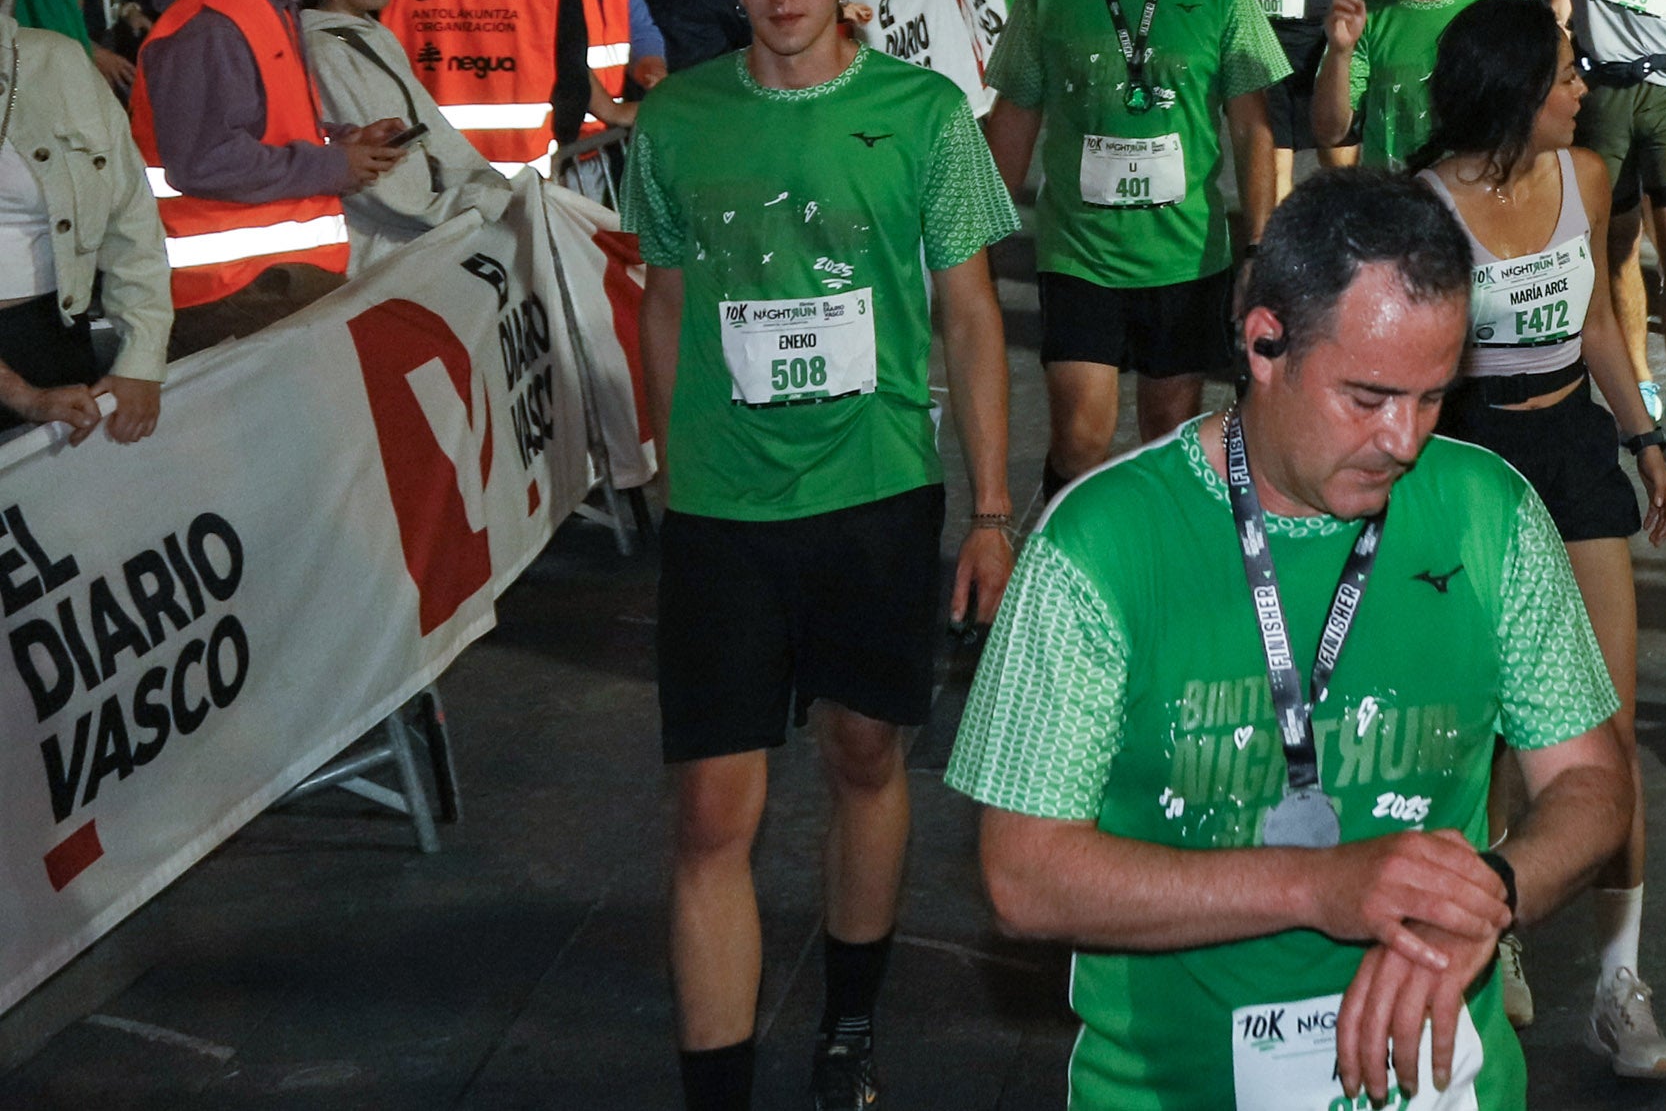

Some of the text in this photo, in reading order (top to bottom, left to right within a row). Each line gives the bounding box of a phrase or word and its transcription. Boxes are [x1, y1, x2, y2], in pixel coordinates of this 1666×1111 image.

[412, 8, 518, 19] ANTOLAKUNTZA
[448, 56, 516, 79] negua
[1129, 162, 1137, 172] U
[1116, 177, 1150, 197] 401
[1579, 246, 1586, 259] 4
[813, 257, 854, 277] 2025
[1510, 278, 1569, 306] MARÍA ARCE
[726, 303, 748, 323] 10K
[858, 299, 866, 315] 3
[1515, 300, 1570, 335] F472
[779, 333, 816, 350] ENEKO
[771, 356, 827, 391] 508
[9, 513, 244, 722] DIARIO
[1254, 585, 1292, 671] FINISHER
[1317, 584, 1361, 668] FINISHER
[40, 615, 249, 824] VASCO
[1372, 792, 1432, 822] 2025
[1243, 1008, 1286, 1041] 10K
